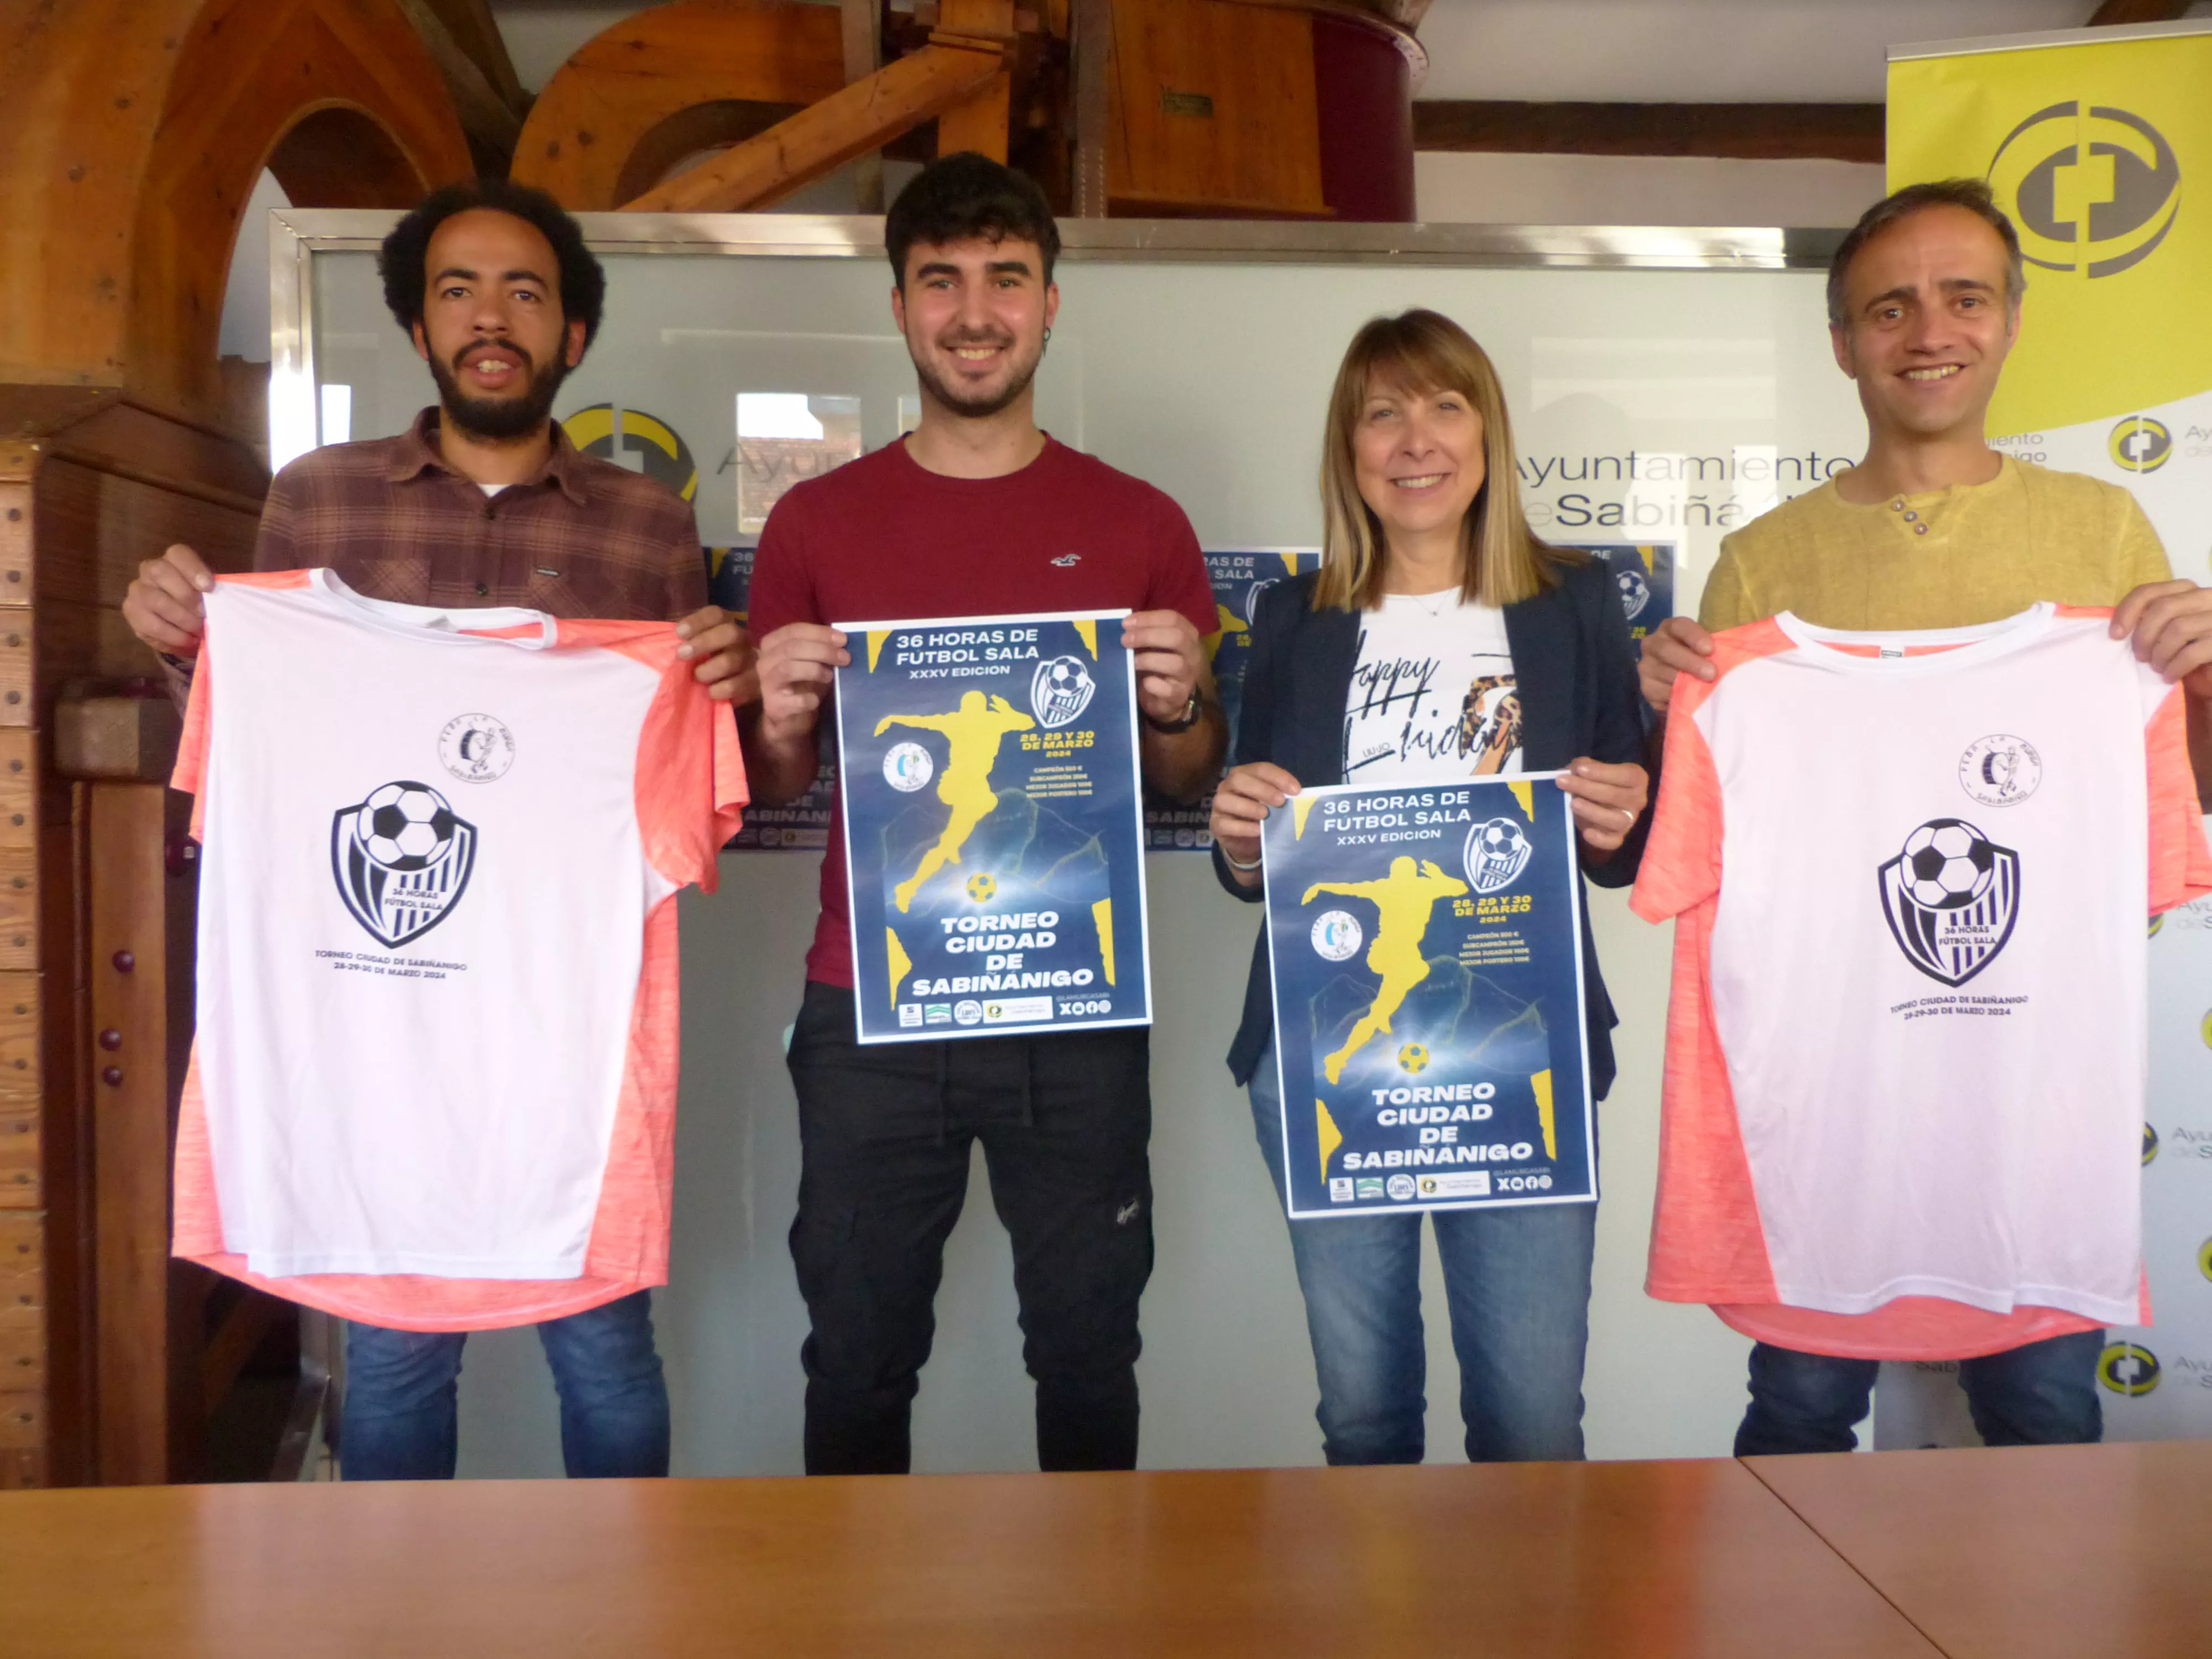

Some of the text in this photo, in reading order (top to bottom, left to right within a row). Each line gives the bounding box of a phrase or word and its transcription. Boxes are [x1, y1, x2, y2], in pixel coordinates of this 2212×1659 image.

[1234, 556, 1254, 567] DE
[1215, 569, 1254, 580] SALA
[896, 629, 1039, 649] 36 HORAS DE
[984, 645, 1039, 661] SALA
[909, 668, 948, 680] XXXV
[1065, 732, 1074, 740] Y
[1022, 739, 1094, 750] DE MARZO
[1323, 791, 1470, 815] 36 HORAS DE
[1414, 808, 1472, 825] SALA
[1337, 834, 1376, 846] XXXV
[1478, 898, 1498, 906] 29
[1500, 896, 1510, 905] Y
[1512, 895, 1532, 904] 30
[1454, 903, 1531, 917] DE MARZO
[940, 911, 1059, 935] TORNEO
[1479, 915, 1507, 924] 2024
[945, 931, 1057, 954] CIUDAD
[1939, 937, 1971, 945] FÚTBOL
[315, 950, 353, 959] TORNEO
[356, 953, 390, 964] CIUDAD
[985, 952, 1023, 972] DE
[388, 969, 420, 978] MARZO
[424, 971, 446, 979] 2024
[1920, 996, 1957, 1005] CIUDAD
[1371, 1082, 1496, 1105] TORNEO
[1377, 1103, 1493, 1126] CIUDAD
[1419, 1125, 1458, 1144] DE
